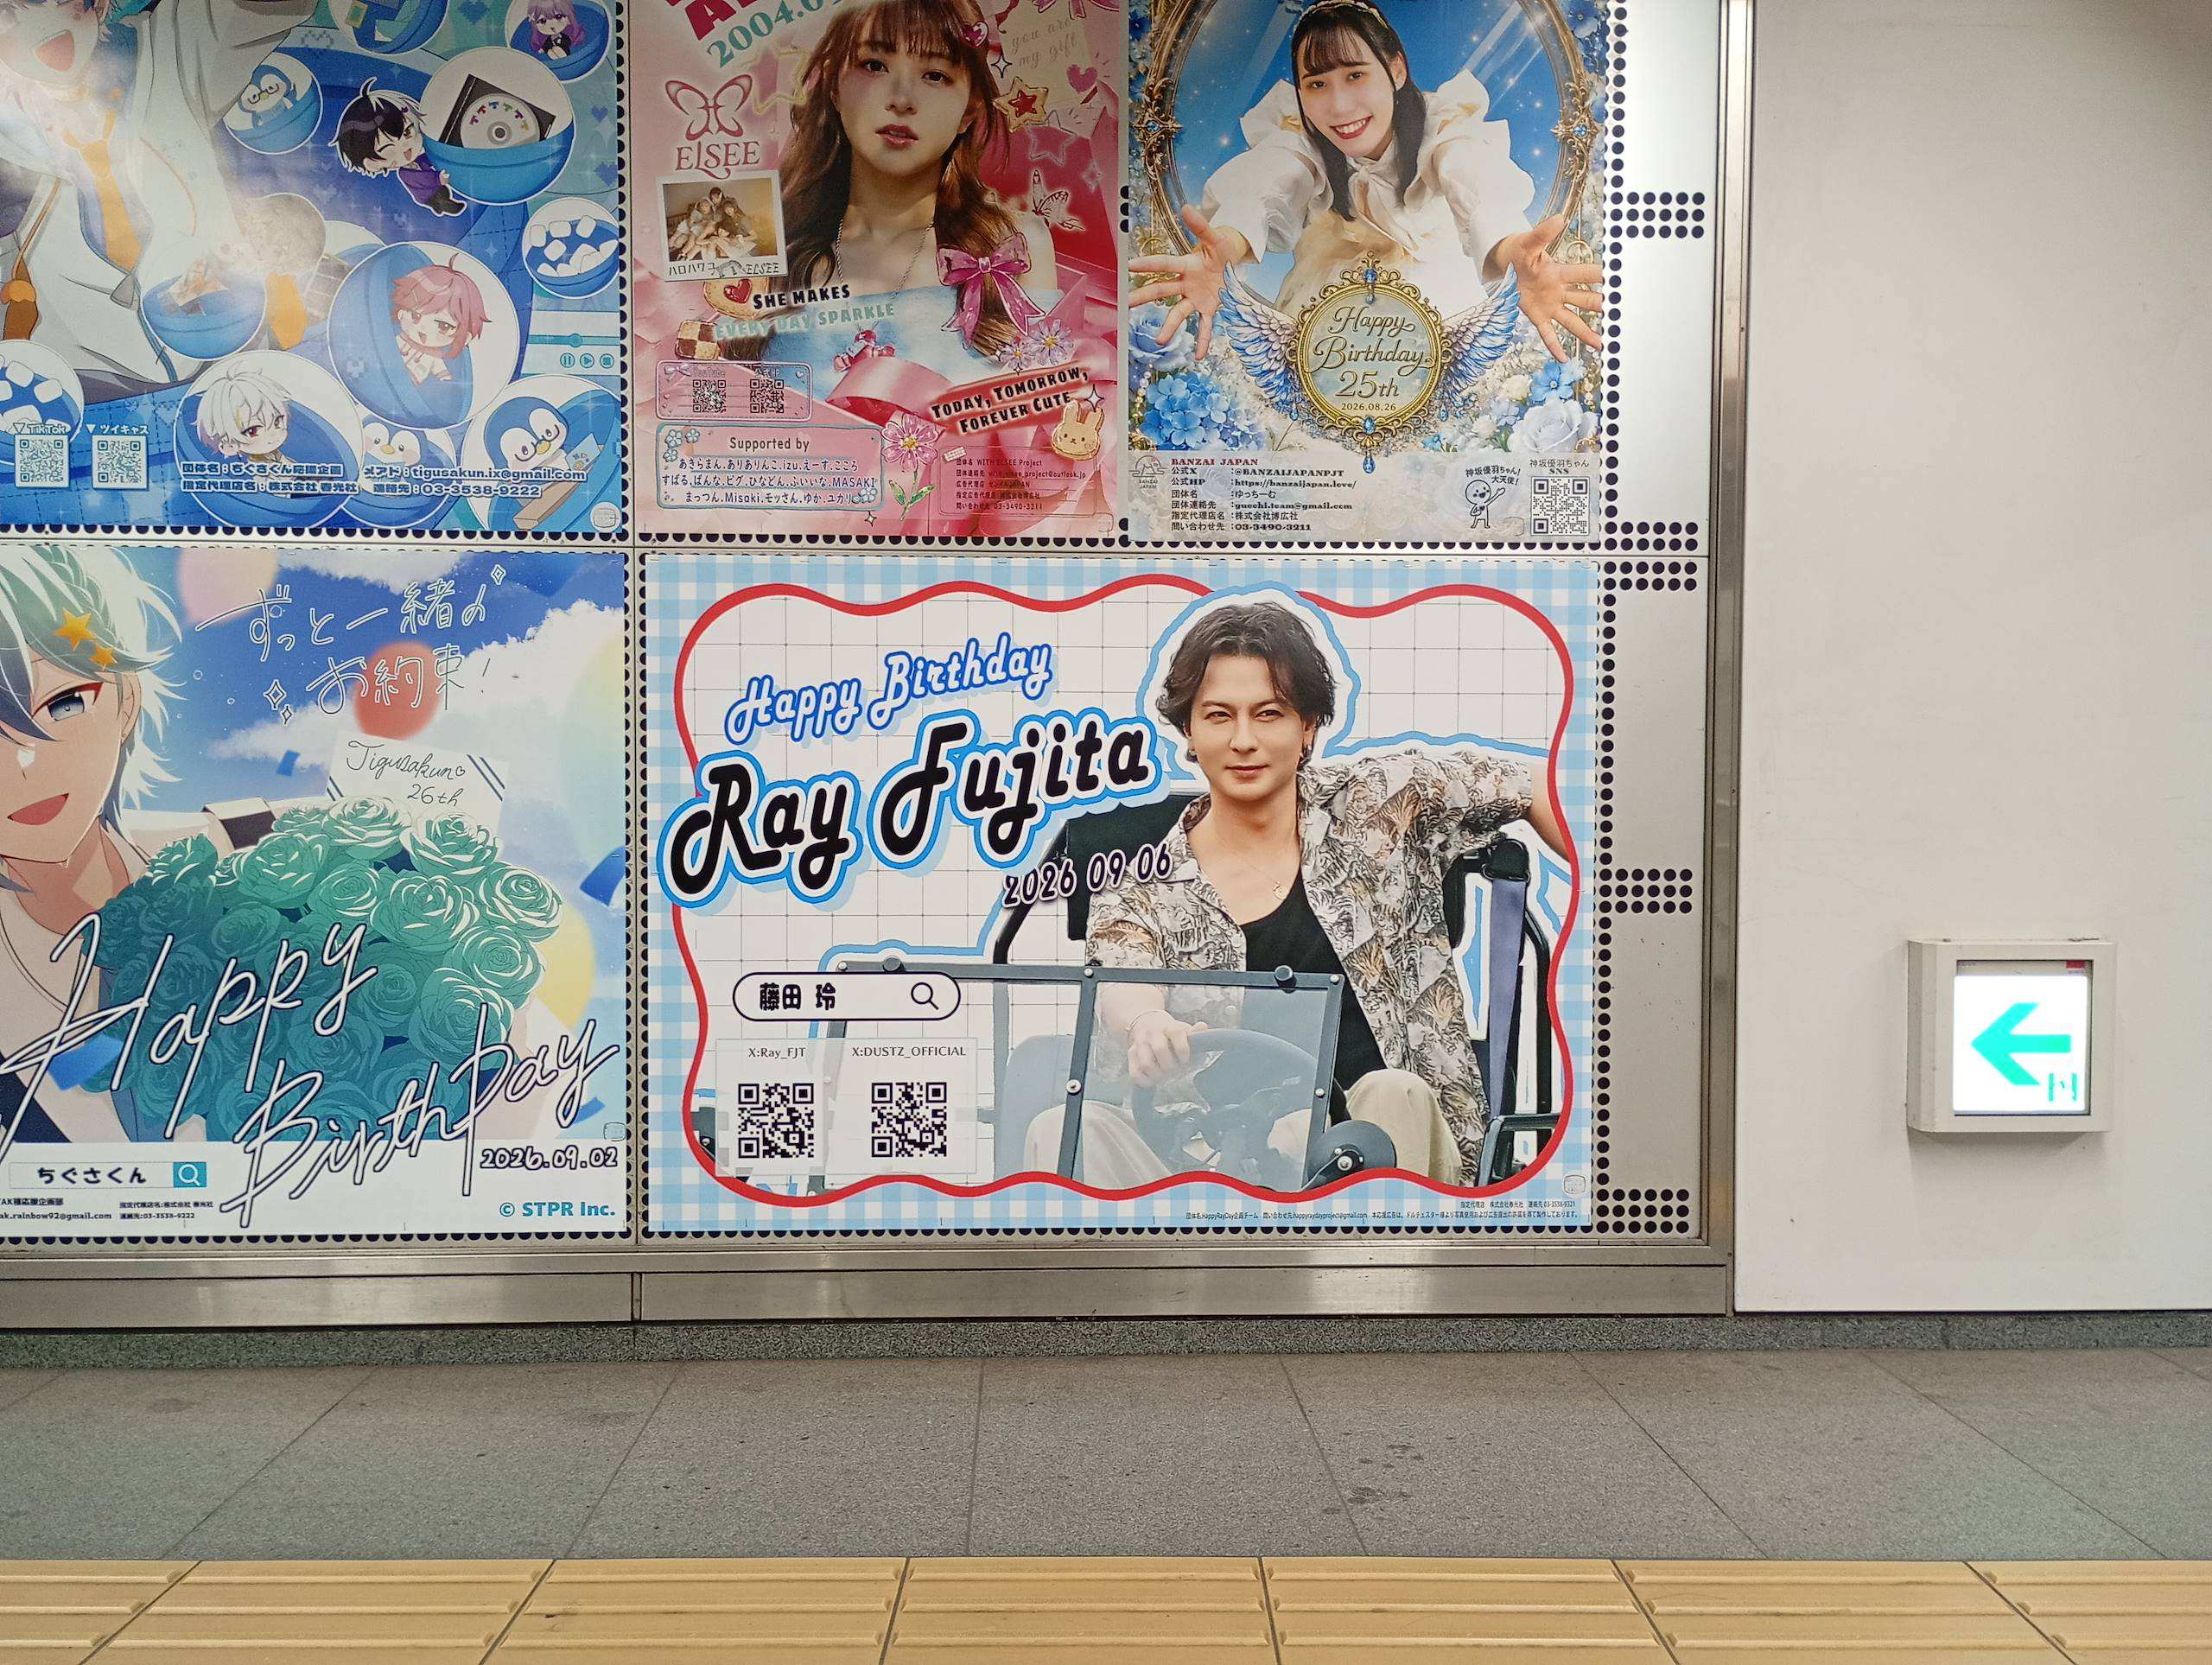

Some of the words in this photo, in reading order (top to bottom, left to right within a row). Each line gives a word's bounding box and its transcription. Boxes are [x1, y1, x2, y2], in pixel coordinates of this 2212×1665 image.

[1011, 29, 1039, 54] you
[1047, 17, 1071, 34] are
[1019, 51, 1039, 69] my
[1048, 32, 1077, 62] gift
[676, 140, 760, 180] ELSEE
[745, 262, 780, 275] ELSEE
[818, 302, 895, 327] SPARKLE
[1327, 305, 1416, 338] Happy
[1304, 335, 1436, 377] Birthday
[1334, 370, 1400, 398] 25th
[1340, 403, 1396, 411] 2026.08.26
[99, 423, 149, 435] ツイキャス
[729, 437, 791, 453] Supported
[795, 437, 810, 452] by
[1171, 477, 1205, 486] 公式HP
[1171, 489, 1198, 499] 団体名
[1171, 500, 1217, 509] 団体連絡先
[1171, 522, 1225, 531] 問い合わせ先
[724, 674, 863, 745] Happy
[867, 631, 1052, 730] Birthday
[407, 784, 465, 807] 26th
[671, 762, 849, 895] Ray
[879, 720, 1149, 857] Fujita
[1002, 862, 1077, 909] 2026
[1086, 859, 1124, 892] 09
[1134, 843, 1173, 882] 06
[760, 982, 801, 1011] 藤田
[816, 982, 836, 1011] 玲
[0, 912, 378, 1163] Happy
[748, 1046, 806, 1059] X:Ray_FJT
[852, 1045, 967, 1058] X:DUSTZ_OFFICIAL
[480, 1145, 618, 1170] 2026.09.02
[37, 1166, 147, 1185] ちぐさくん
[522, 1201, 574, 1217] STPR
[580, 1201, 616, 1217] Inc.
